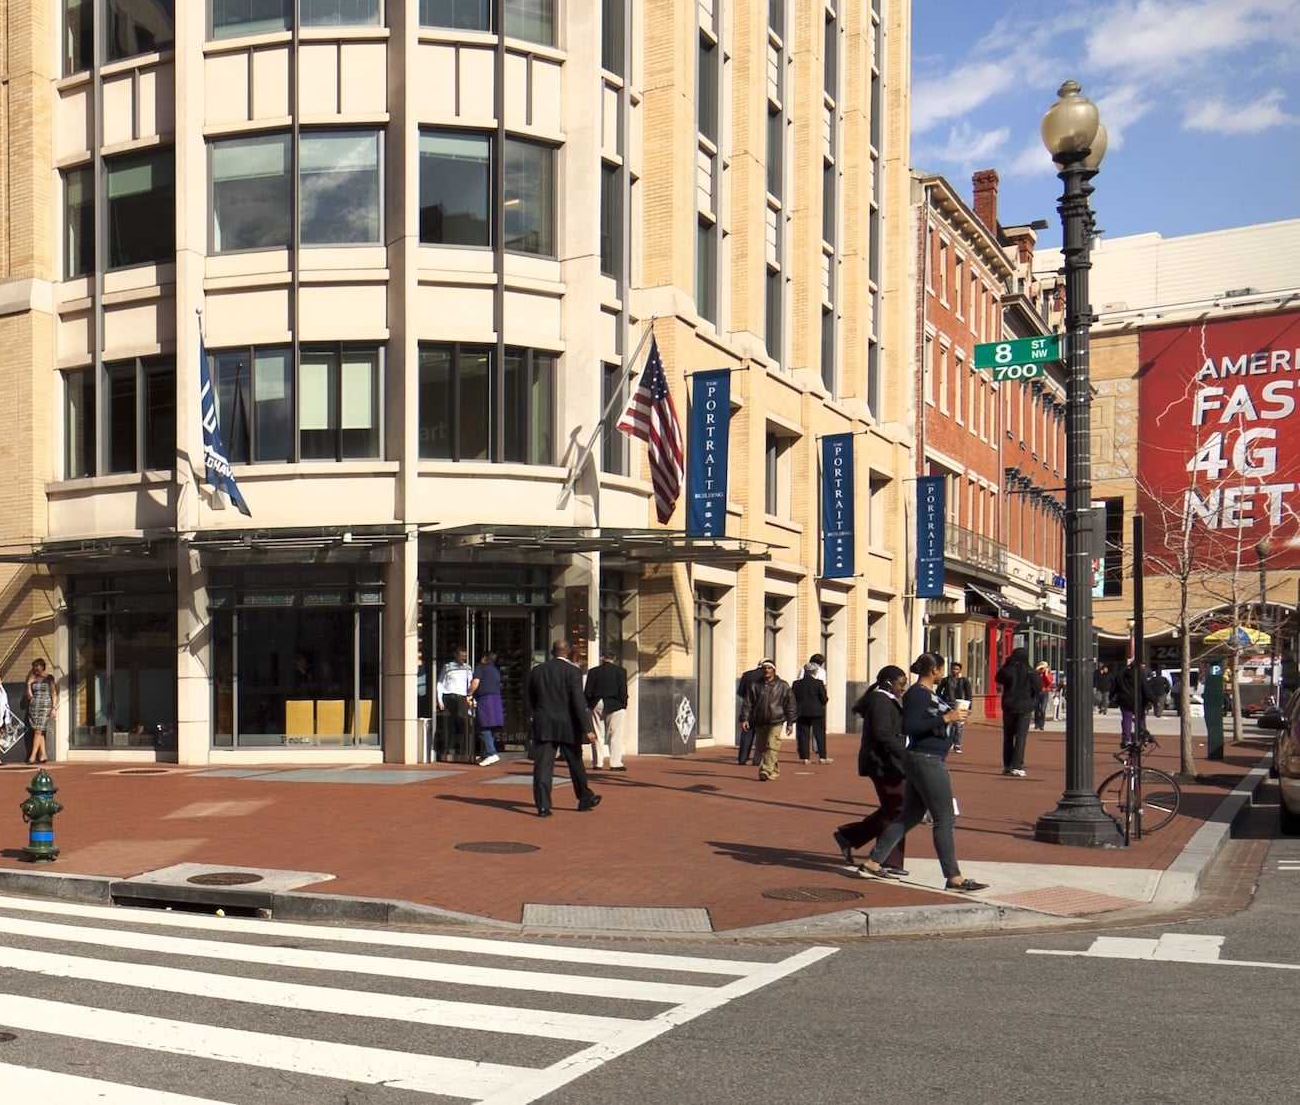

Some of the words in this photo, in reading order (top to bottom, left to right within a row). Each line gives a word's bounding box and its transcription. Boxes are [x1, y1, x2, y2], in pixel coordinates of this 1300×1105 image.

[994, 343, 1013, 363] 8
[1031, 339, 1047, 349] ST
[995, 364, 1037, 380] 700
[1031, 348, 1048, 359] NW
[1192, 379, 1300, 426] FAS
[705, 387, 716, 490] PORTRAIT
[1186, 427, 1277, 480] 4G
[834, 446, 844, 530] PORTRAIT
[1181, 482, 1300, 531] NET
[927, 486, 935, 556] PORTRAIT
[1212, 665, 1221, 675] P
